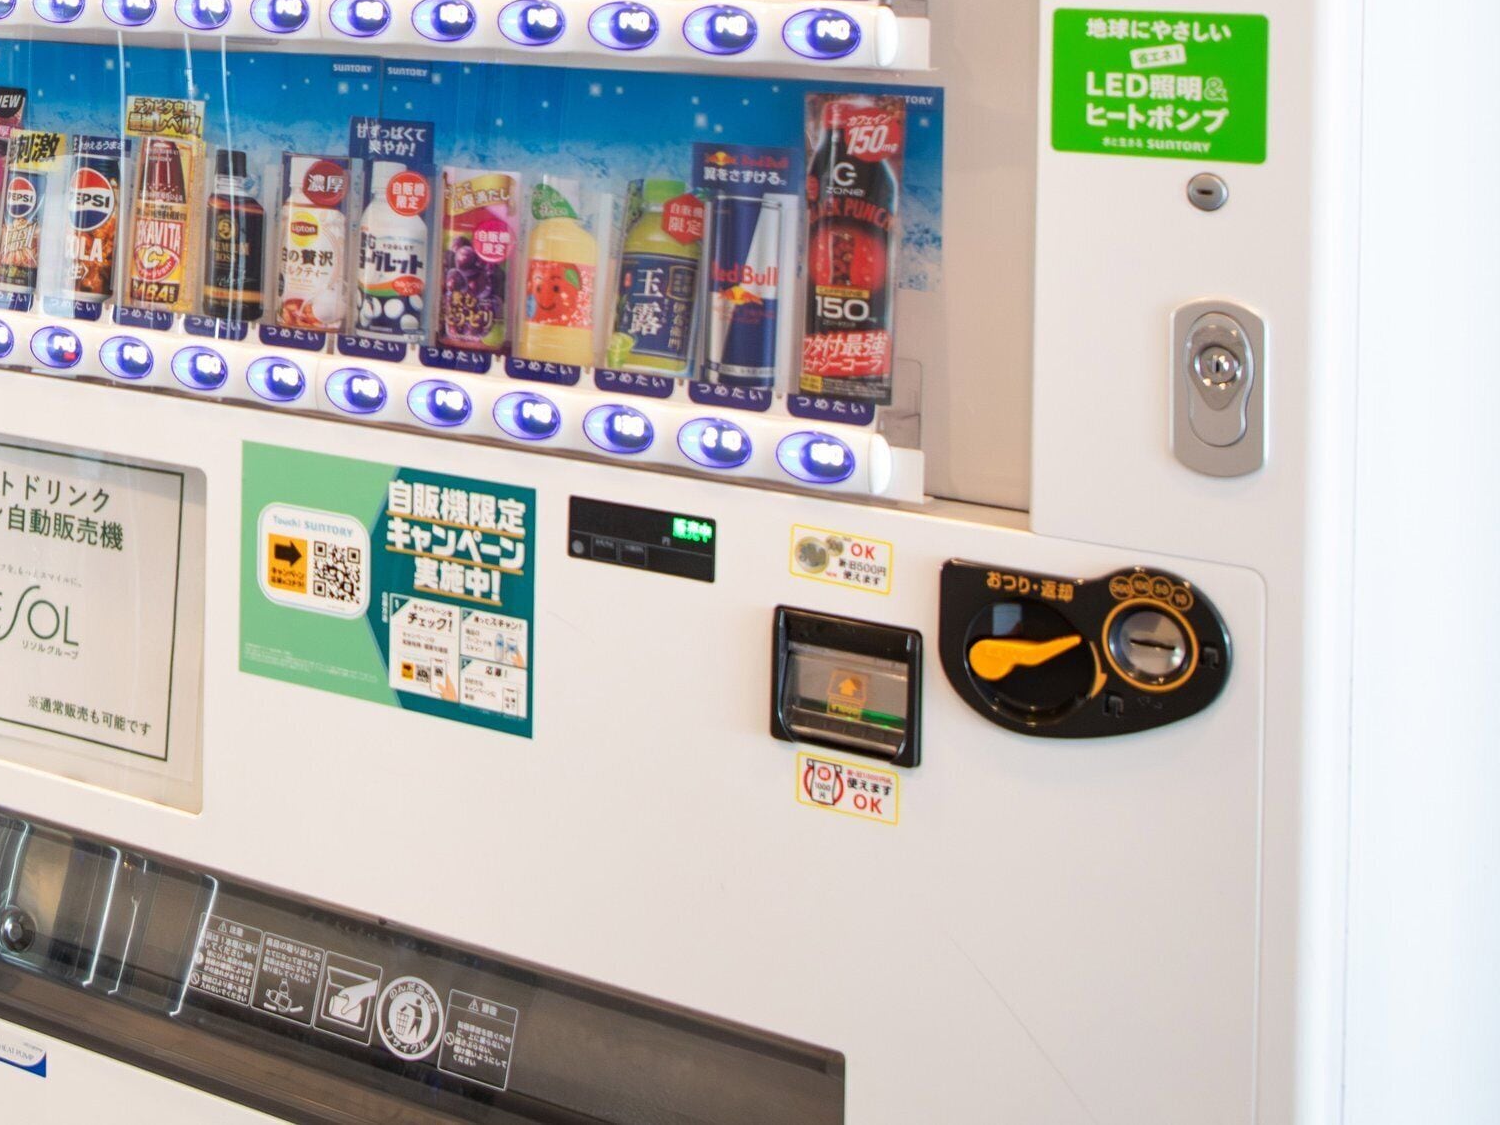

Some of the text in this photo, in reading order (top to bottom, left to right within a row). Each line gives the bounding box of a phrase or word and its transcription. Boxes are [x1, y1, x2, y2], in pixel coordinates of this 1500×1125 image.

[1085, 17, 1232, 43] 地球にやさしい
[332, 62, 373, 74] SUNTORY
[387, 66, 428, 78] SUNTORY
[1085, 70, 1229, 102] LED照明&
[1085, 102, 1230, 135] ヒートポンプ
[355, 124, 427, 144] 甘ずっぱくて
[1146, 138, 1212, 153] SUNTORY
[307, 173, 344, 193] 濃厚
[391, 181, 426, 197] 自販機
[395, 195, 420, 210] 限定
[741, 264, 779, 287] Bull
[628, 268, 664, 336] 玉露
[815, 295, 870, 321] 150
[388, 479, 527, 536] 自販機限定
[304, 520, 354, 538] SUNTORY
[386, 517, 525, 570] キャンペーン
[850, 542, 876, 560] OK
[413, 556, 502, 602] 実施中!
[407, 612, 453, 633] チェック!
[21, 639, 80, 660] リソルグループ
[846, 777, 892, 796] 使えます
[853, 793, 883, 815] OK
